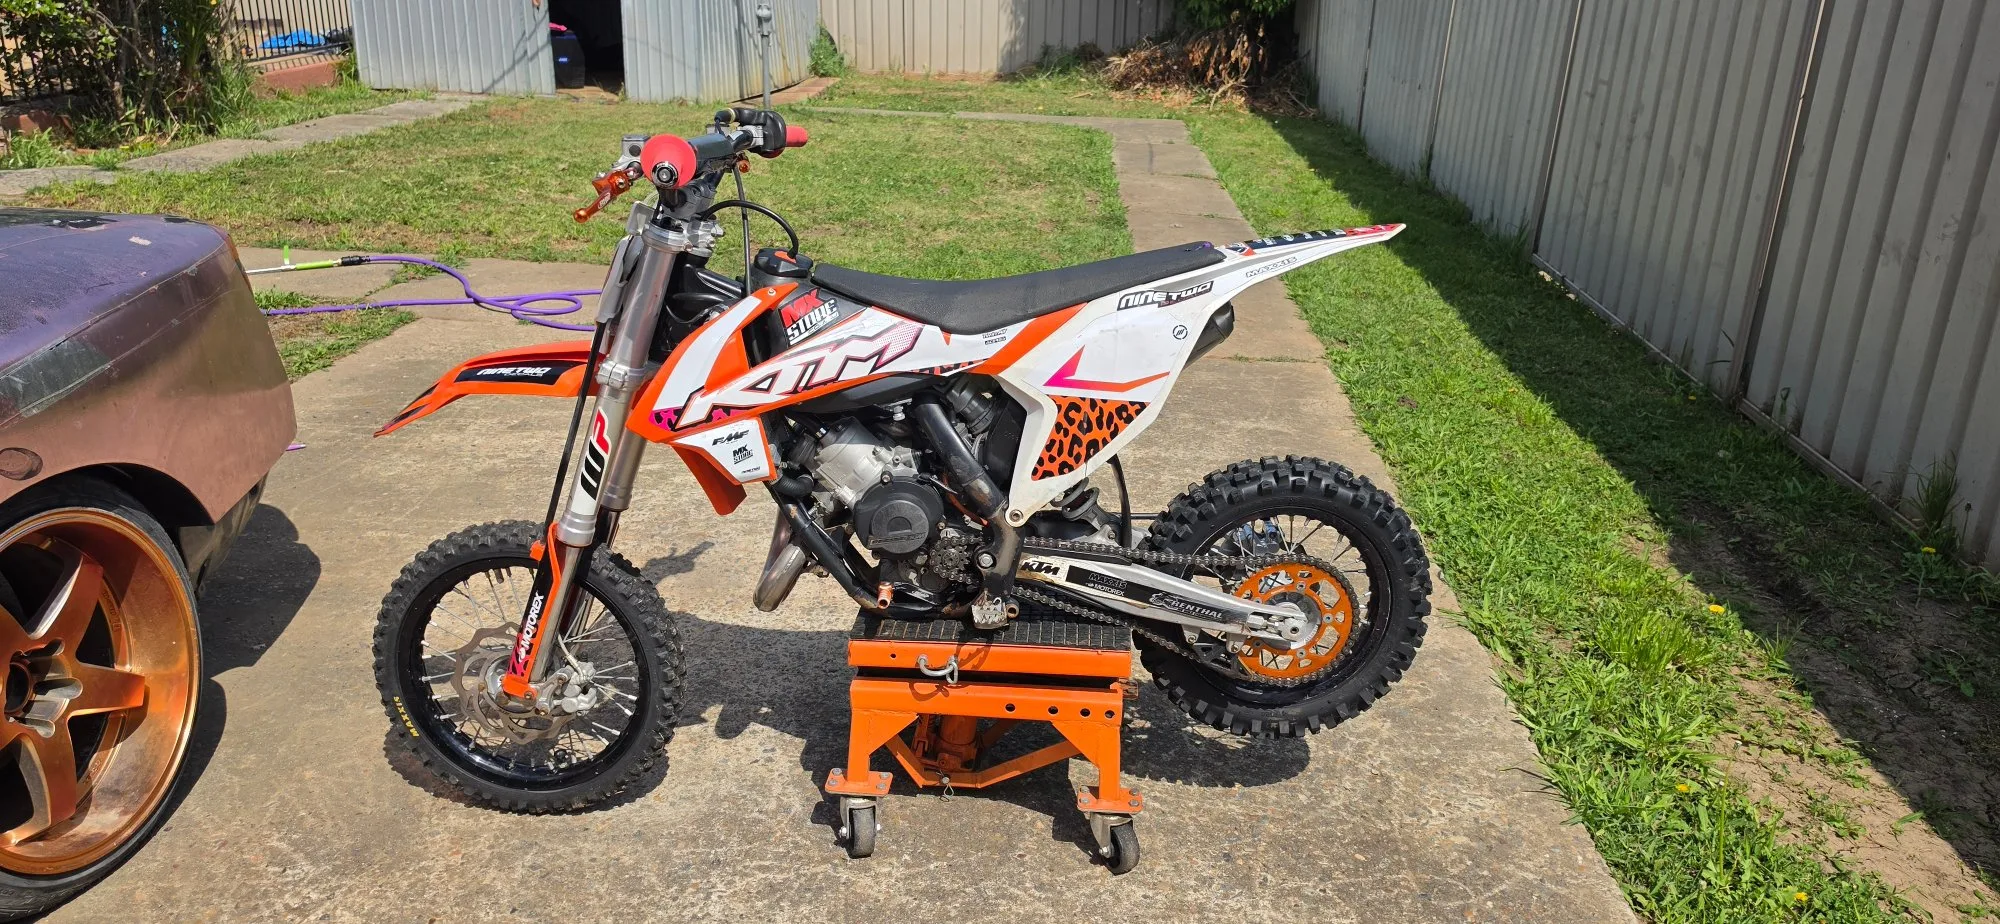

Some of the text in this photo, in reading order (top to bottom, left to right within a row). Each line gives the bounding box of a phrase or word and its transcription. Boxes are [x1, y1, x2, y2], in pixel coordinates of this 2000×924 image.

[1246, 257, 1298, 278] MAXXIS
[781, 288, 825, 329] MX
[786, 299, 837, 341] STORE
[673, 322, 925, 432] KTM
[712, 430, 750, 446] FMF
[733, 444, 748, 457] MX
[1021, 560, 1060, 576] KTM
[1088, 573, 1127, 589] MAXXIS
[1093, 584, 1124, 596] MOTOREX
[521, 590, 544, 648] MOTOREX
[1171, 600, 1222, 619] RENTHAL
[393, 696, 420, 737] MAXXIS
